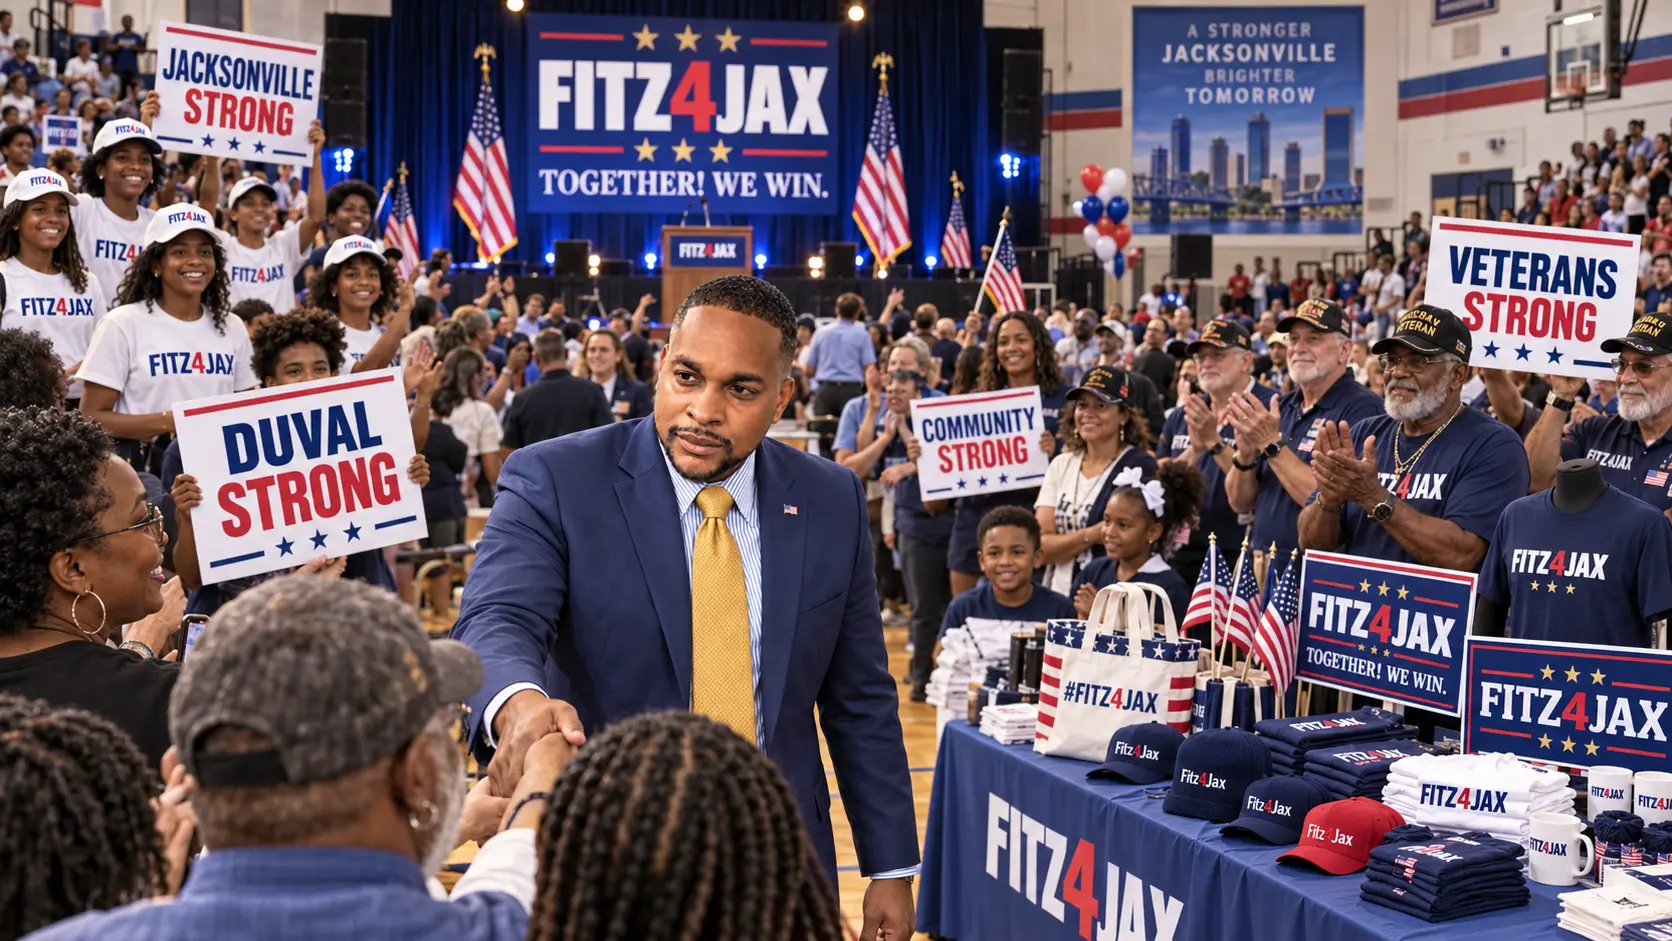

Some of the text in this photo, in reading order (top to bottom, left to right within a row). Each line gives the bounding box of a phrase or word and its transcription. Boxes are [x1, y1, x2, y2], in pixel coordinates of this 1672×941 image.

[1187, 22, 1311, 38] A STRONGER
[1162, 43, 1336, 63] JACKSONVILLE
[162, 47, 315, 100] JACKSONVILLE
[1204, 68, 1295, 83] BRIGHTER
[539, 59, 829, 135] FITZ4JAX
[1185, 87, 1315, 104] TOMORROW
[183, 87, 294, 137] STRONG
[539, 169, 829, 198] TOGETHER! WE WIN.
[168, 211, 206, 225] FITZ4JAX
[95, 239, 143, 261] FITZ4
[679, 242, 737, 258] FITZ4JAX
[231, 263, 284, 284] FITZ4JAX
[1449, 245, 1618, 300] VETERANS
[20, 297, 94, 317] FITZ4JAX
[1462, 291, 1597, 343] STRONG
[148, 351, 234, 377] FITZ4JAX
[222, 401, 383, 475] DUVAL
[922, 406, 1035, 443] COMMUNITY
[937, 435, 1029, 473] STRONG
[1586, 448, 1633, 470] FITZ4JAX
[217, 452, 402, 538] STRONG
[1377, 472, 1447, 501] TZ4JAX
[1511, 548, 1609, 580] FITZ4JAX
[1308, 591, 1456, 659] FITZ4JAX
[1306, 646, 1447, 695] TOGETHER! WE WIN.
[1064, 681, 1159, 714] #FITZ4JAX
[1480, 681, 1668, 742] FITZ4JAX
[1115, 741, 1160, 760] Fitz4Jax
[1180, 768, 1227, 790] Fitz4Jax
[1247, 795, 1292, 817] Fitz4Jax
[1420, 783, 1508, 814] FITZ4JAX
[1591, 786, 1625, 800] FITZ4JAX
[1638, 794, 1672, 810] FITZ4J
[1306, 823, 1354, 847] Fitz4Jax
[1530, 837, 1567, 857] FITZ4JAX
[985, 791, 1184, 941] FITZ4JAX
